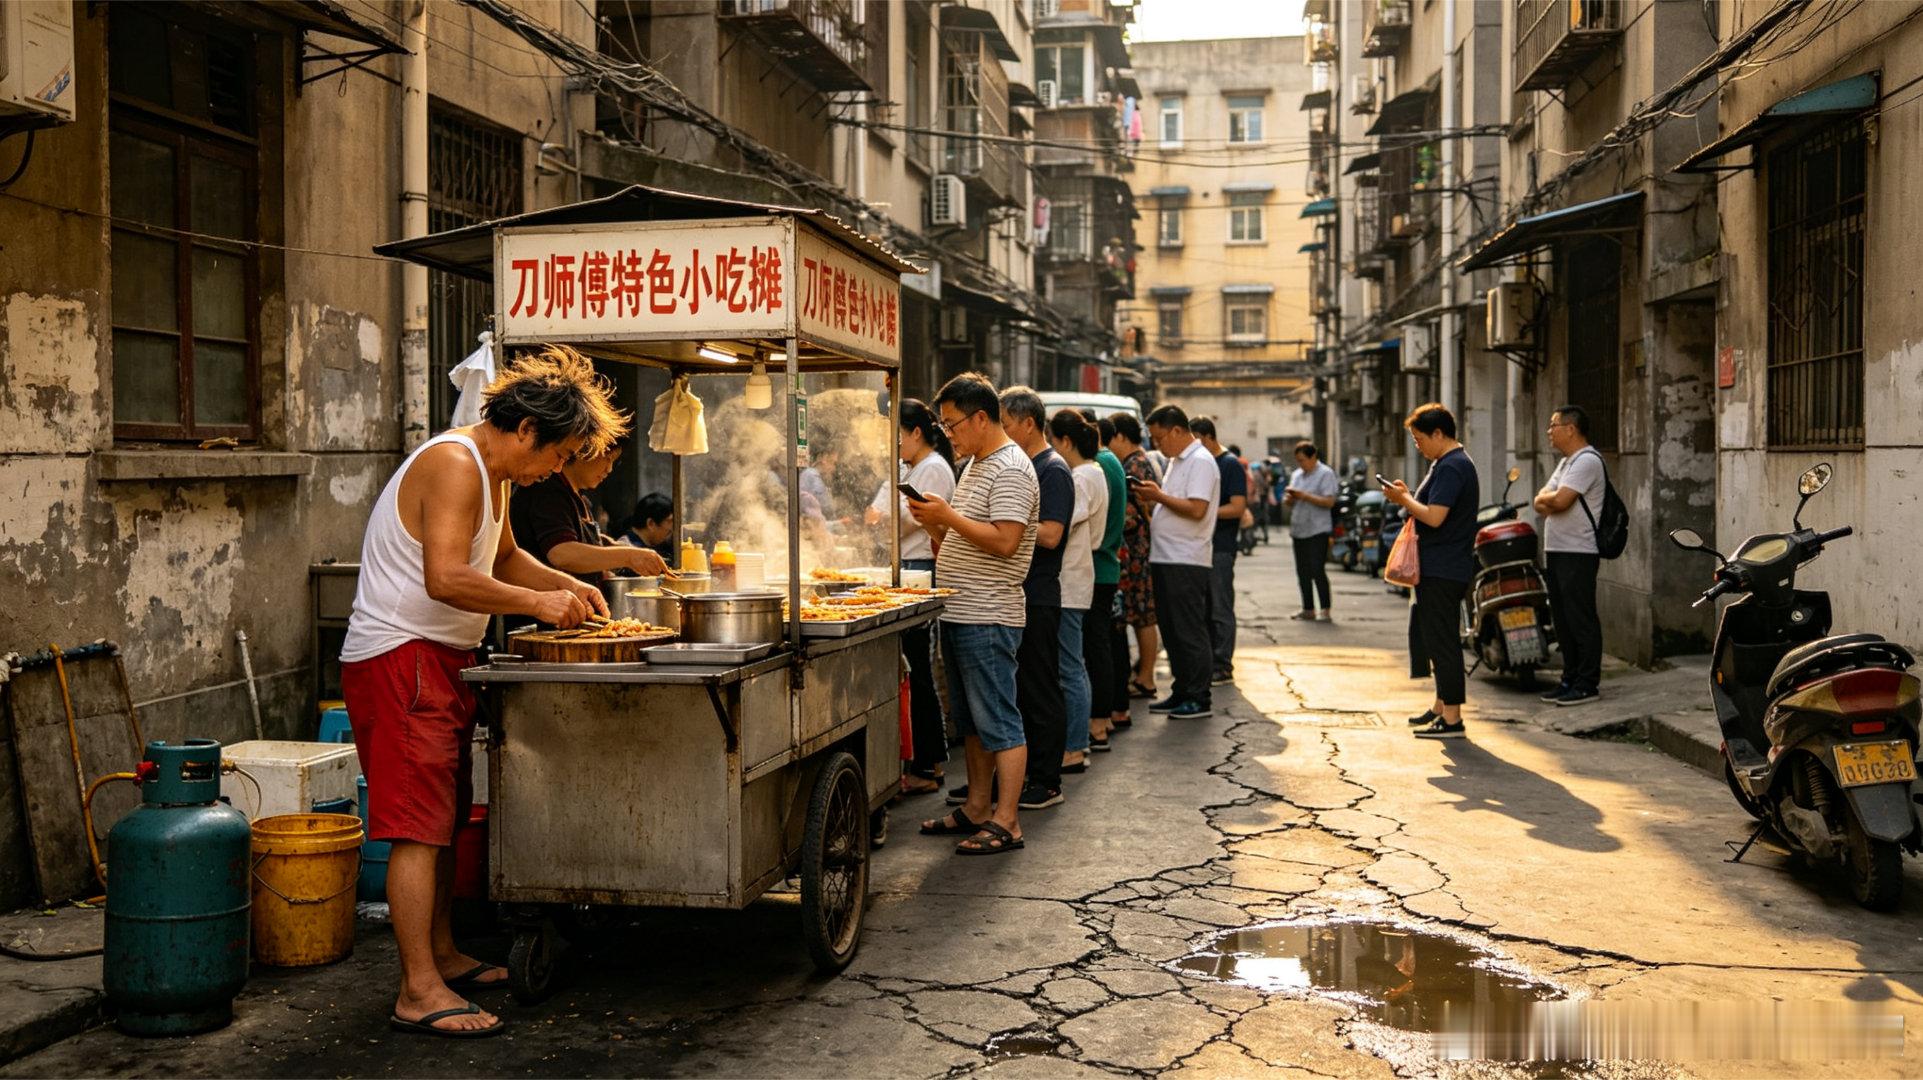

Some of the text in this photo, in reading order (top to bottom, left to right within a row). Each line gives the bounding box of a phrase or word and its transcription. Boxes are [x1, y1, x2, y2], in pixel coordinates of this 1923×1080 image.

[509, 246, 782, 319] 刀师傅特色小吃摊
